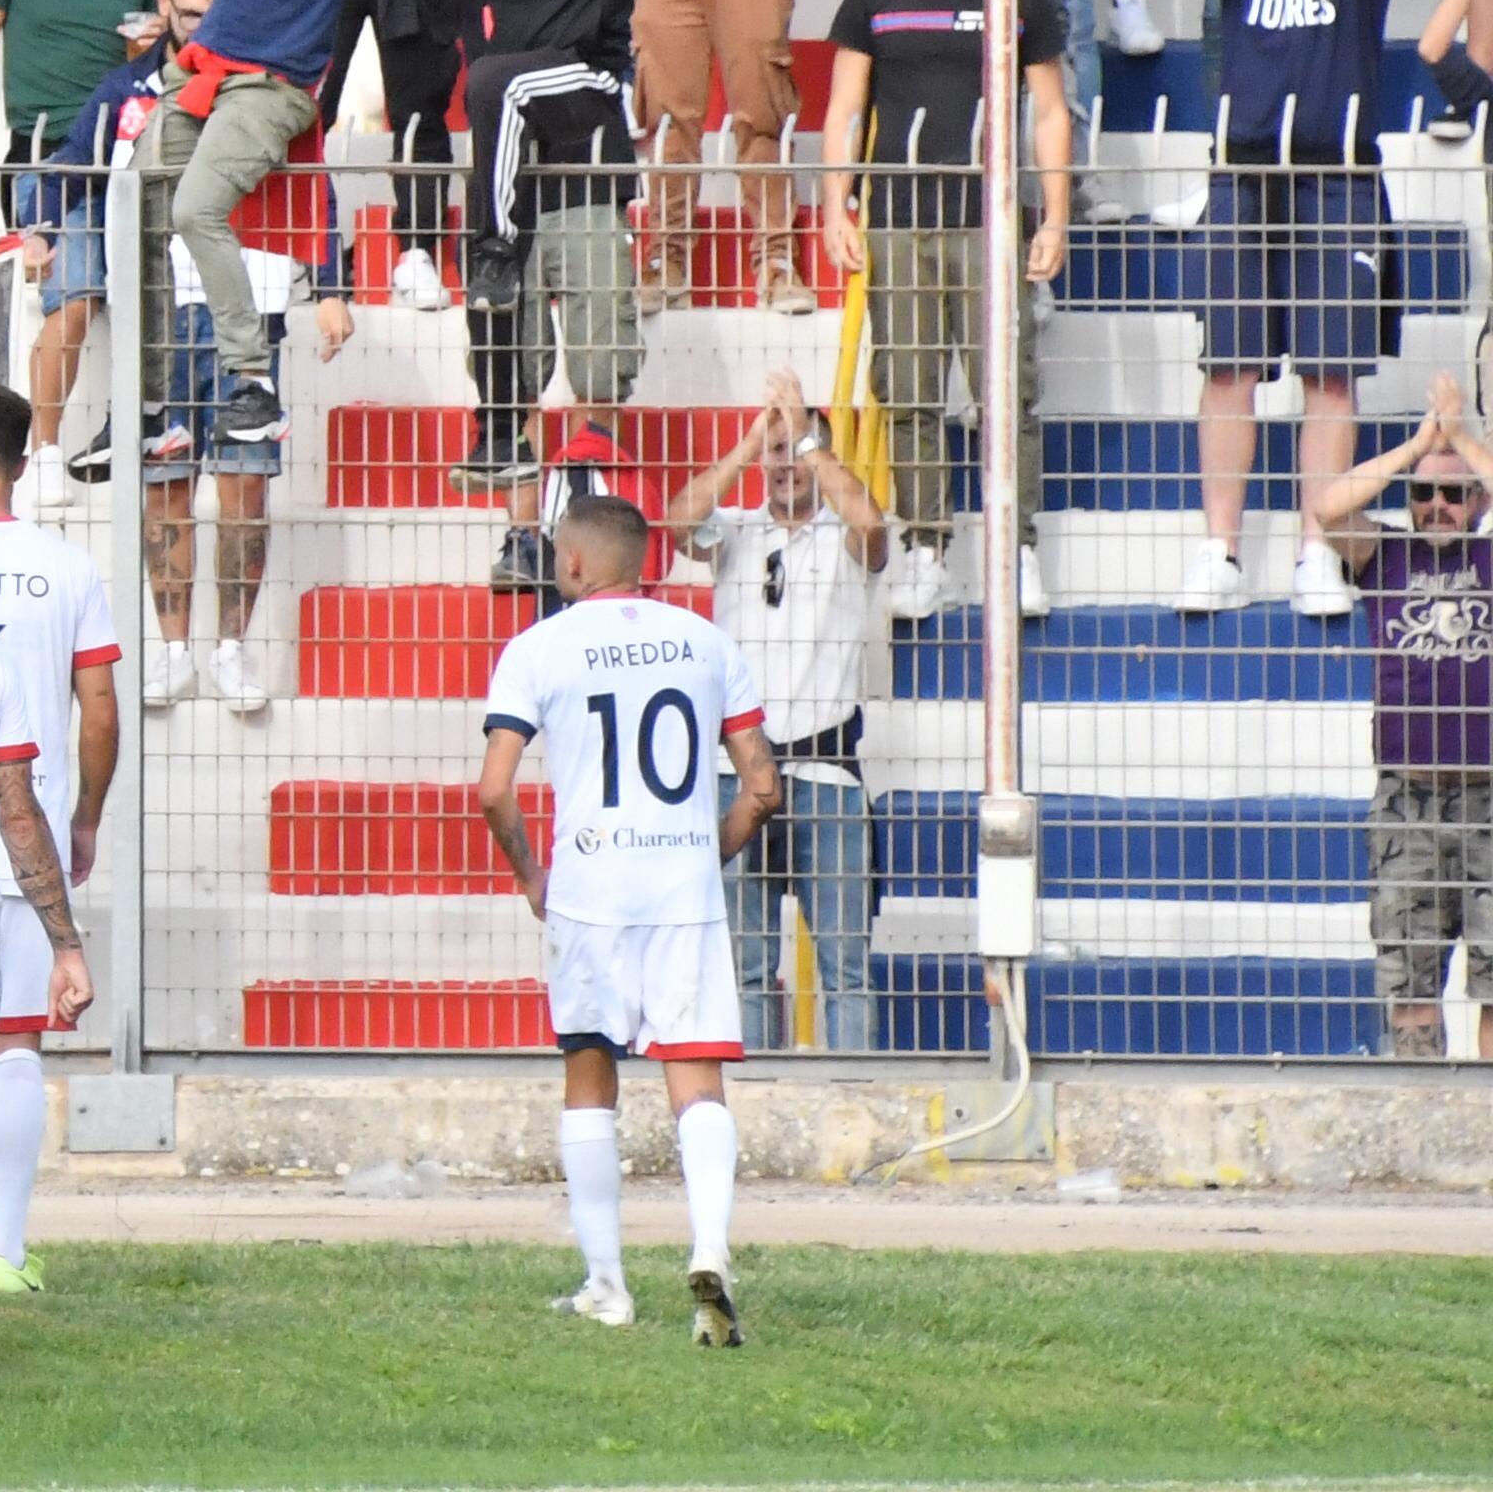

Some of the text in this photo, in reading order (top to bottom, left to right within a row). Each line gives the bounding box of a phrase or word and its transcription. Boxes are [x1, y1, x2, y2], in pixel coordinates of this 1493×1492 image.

[585, 639, 694, 670] PIREDDA
[587, 687, 699, 808] 10
[613, 827, 711, 850] Character
